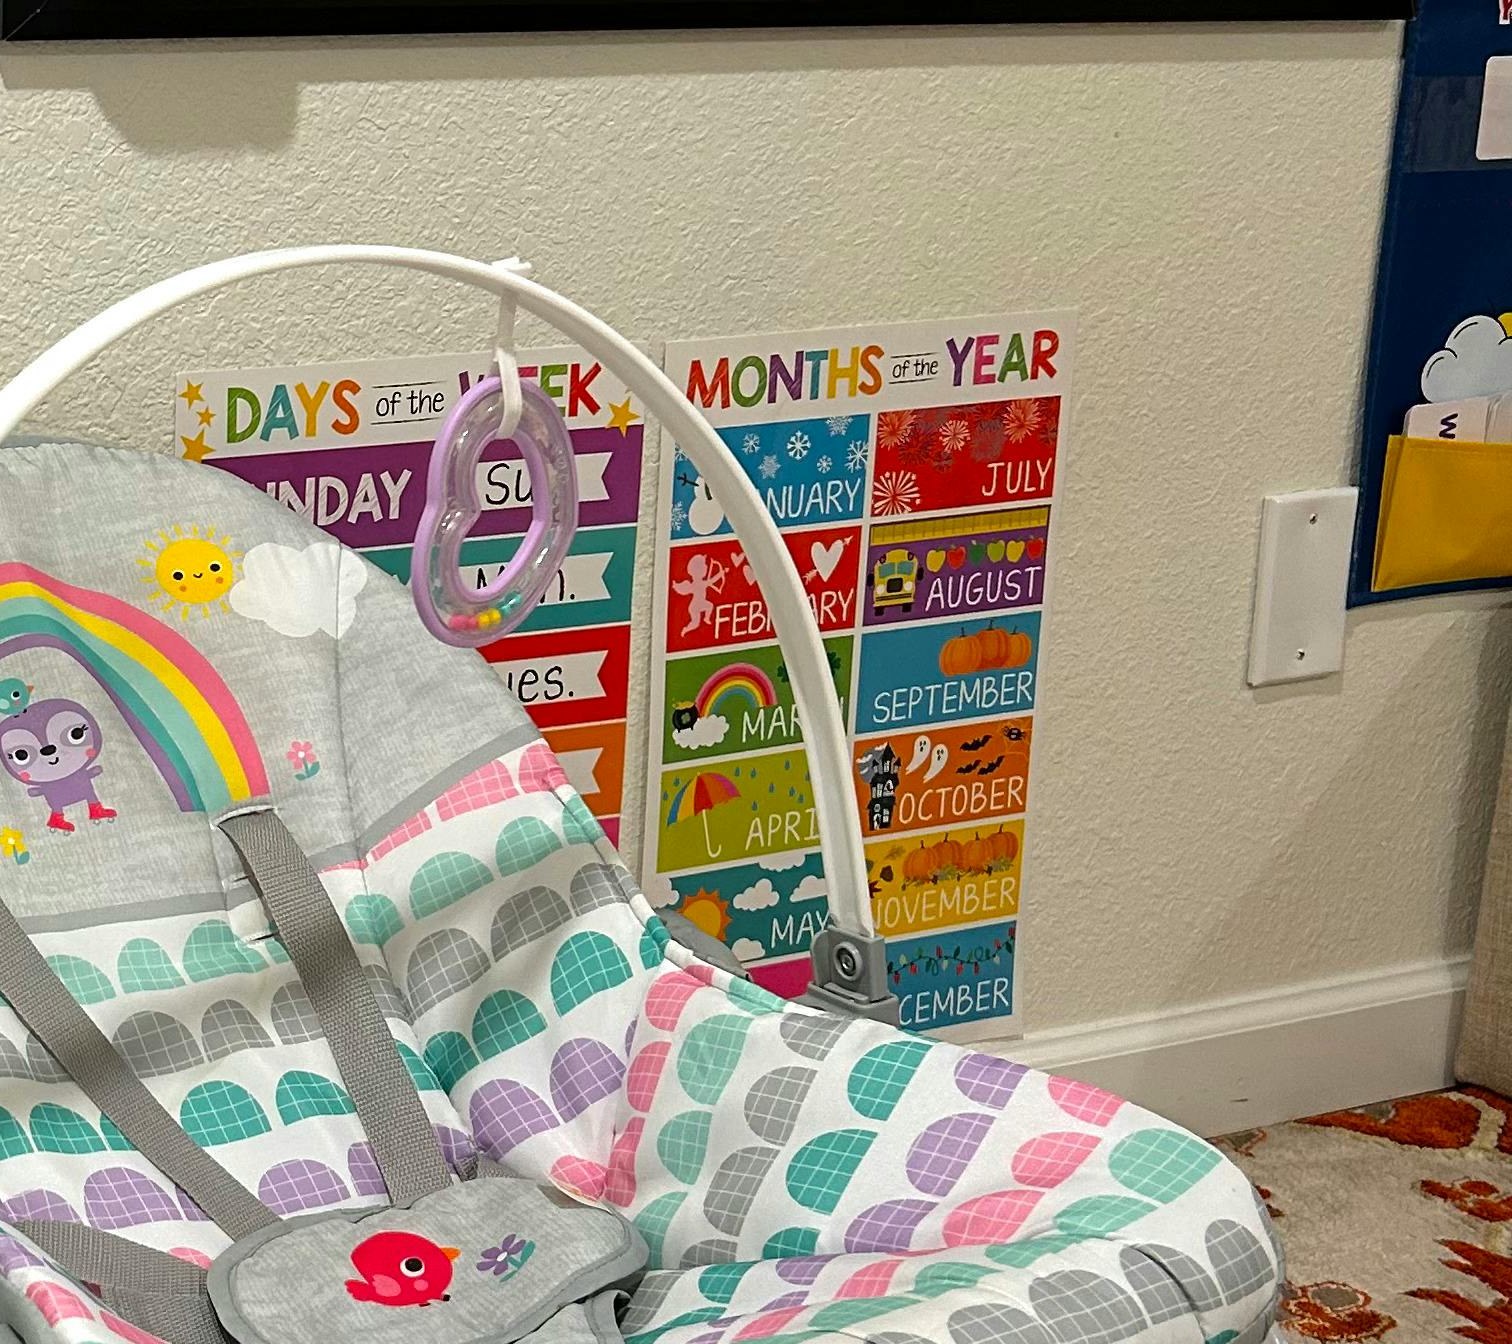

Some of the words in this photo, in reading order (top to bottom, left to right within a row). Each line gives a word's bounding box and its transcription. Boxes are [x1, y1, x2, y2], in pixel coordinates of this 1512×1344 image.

[686, 344, 885, 410] MONTHS
[892, 360, 912, 380] of
[914, 355, 939, 377] the
[946, 329, 1060, 388] YEAR
[226, 379, 362, 444] DAYS
[375, 391, 402, 417] of
[406, 389, 445, 415] the
[254, 469, 412, 526] NDAY
[766, 477, 862, 519] NUARY
[981, 457, 1052, 498] JULY
[925, 566, 1042, 612] AUGUST
[872, 670, 1033, 724] SEPTEMBER
[898, 775, 1025, 825] OCTOBER
[745, 807, 821, 851] APRI
[771, 909, 831, 949] MAY
[898, 977, 1009, 1026] CEMBER
